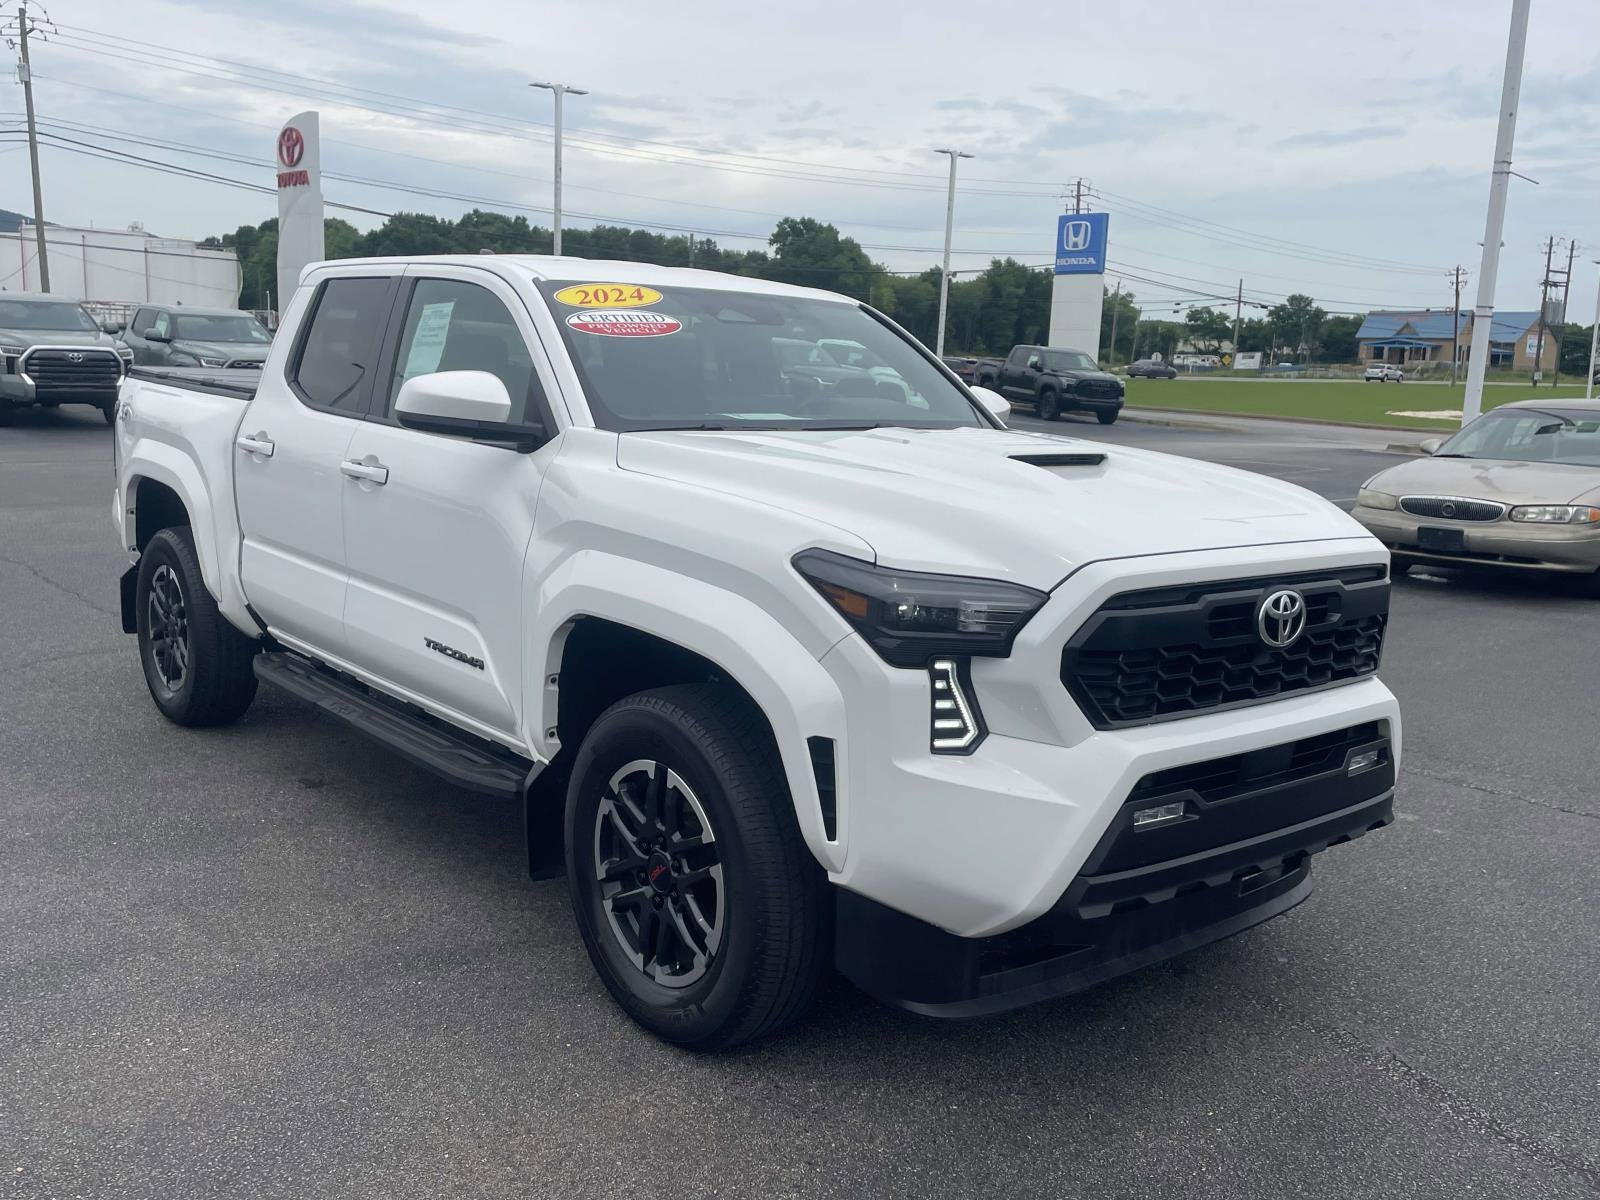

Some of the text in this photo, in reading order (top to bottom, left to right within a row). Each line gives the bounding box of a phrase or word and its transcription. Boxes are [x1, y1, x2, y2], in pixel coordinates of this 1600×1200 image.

[1056, 257, 1096, 266] HONDA
[575, 287, 645, 305] 2024
[576, 314, 666, 323] CERTIFIED
[424, 636, 485, 671] TACOMA
